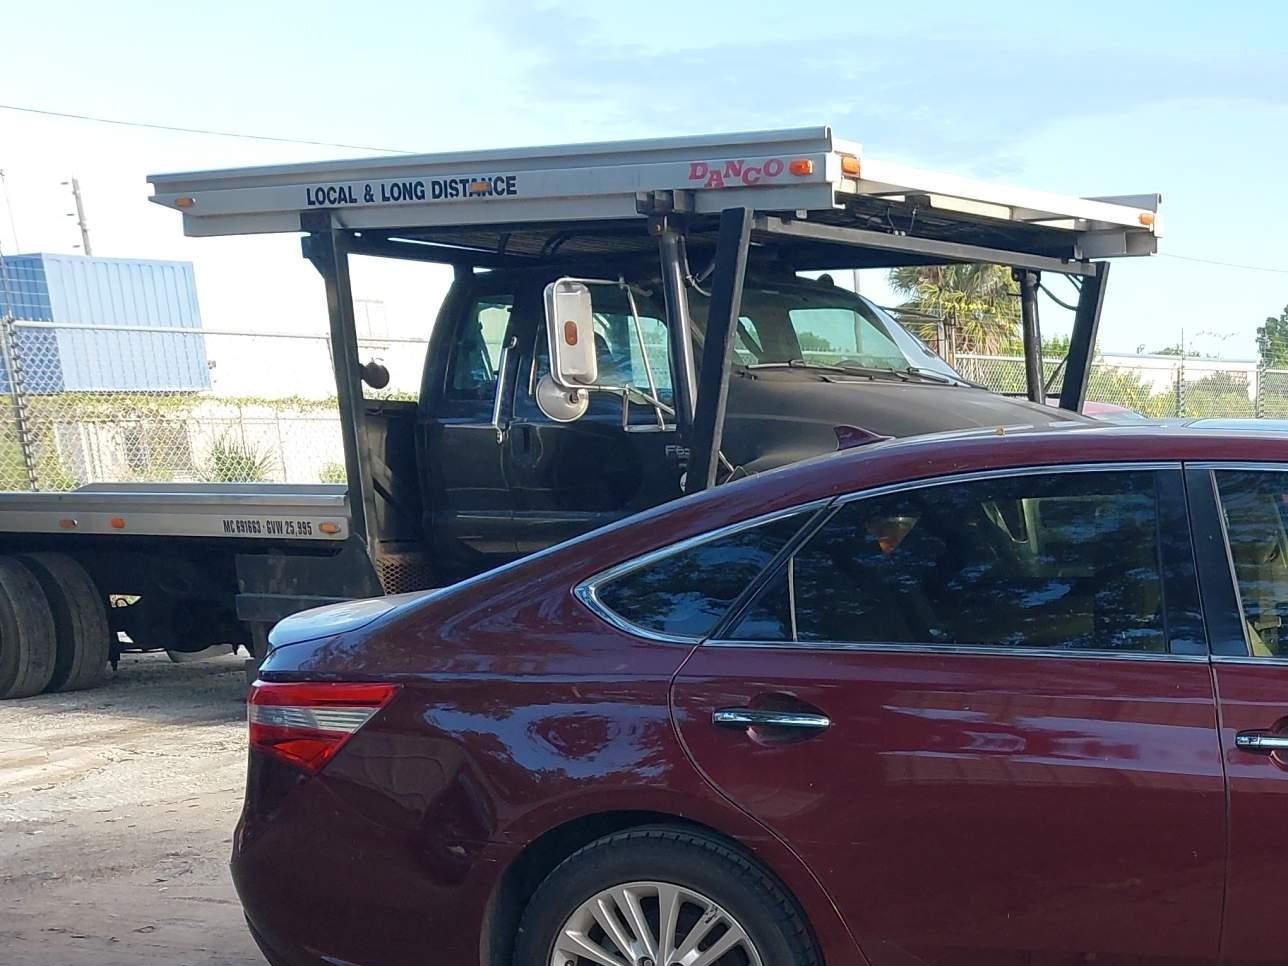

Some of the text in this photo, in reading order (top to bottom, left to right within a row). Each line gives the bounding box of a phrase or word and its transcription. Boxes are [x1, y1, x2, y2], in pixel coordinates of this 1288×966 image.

[688, 159, 784, 188] DANCO
[306, 185, 357, 206] LOCAL
[363, 183, 375, 203] &
[381, 181, 426, 202] LONG
[223, 520, 235, 534] MC
[266, 520, 283, 535] GVW
